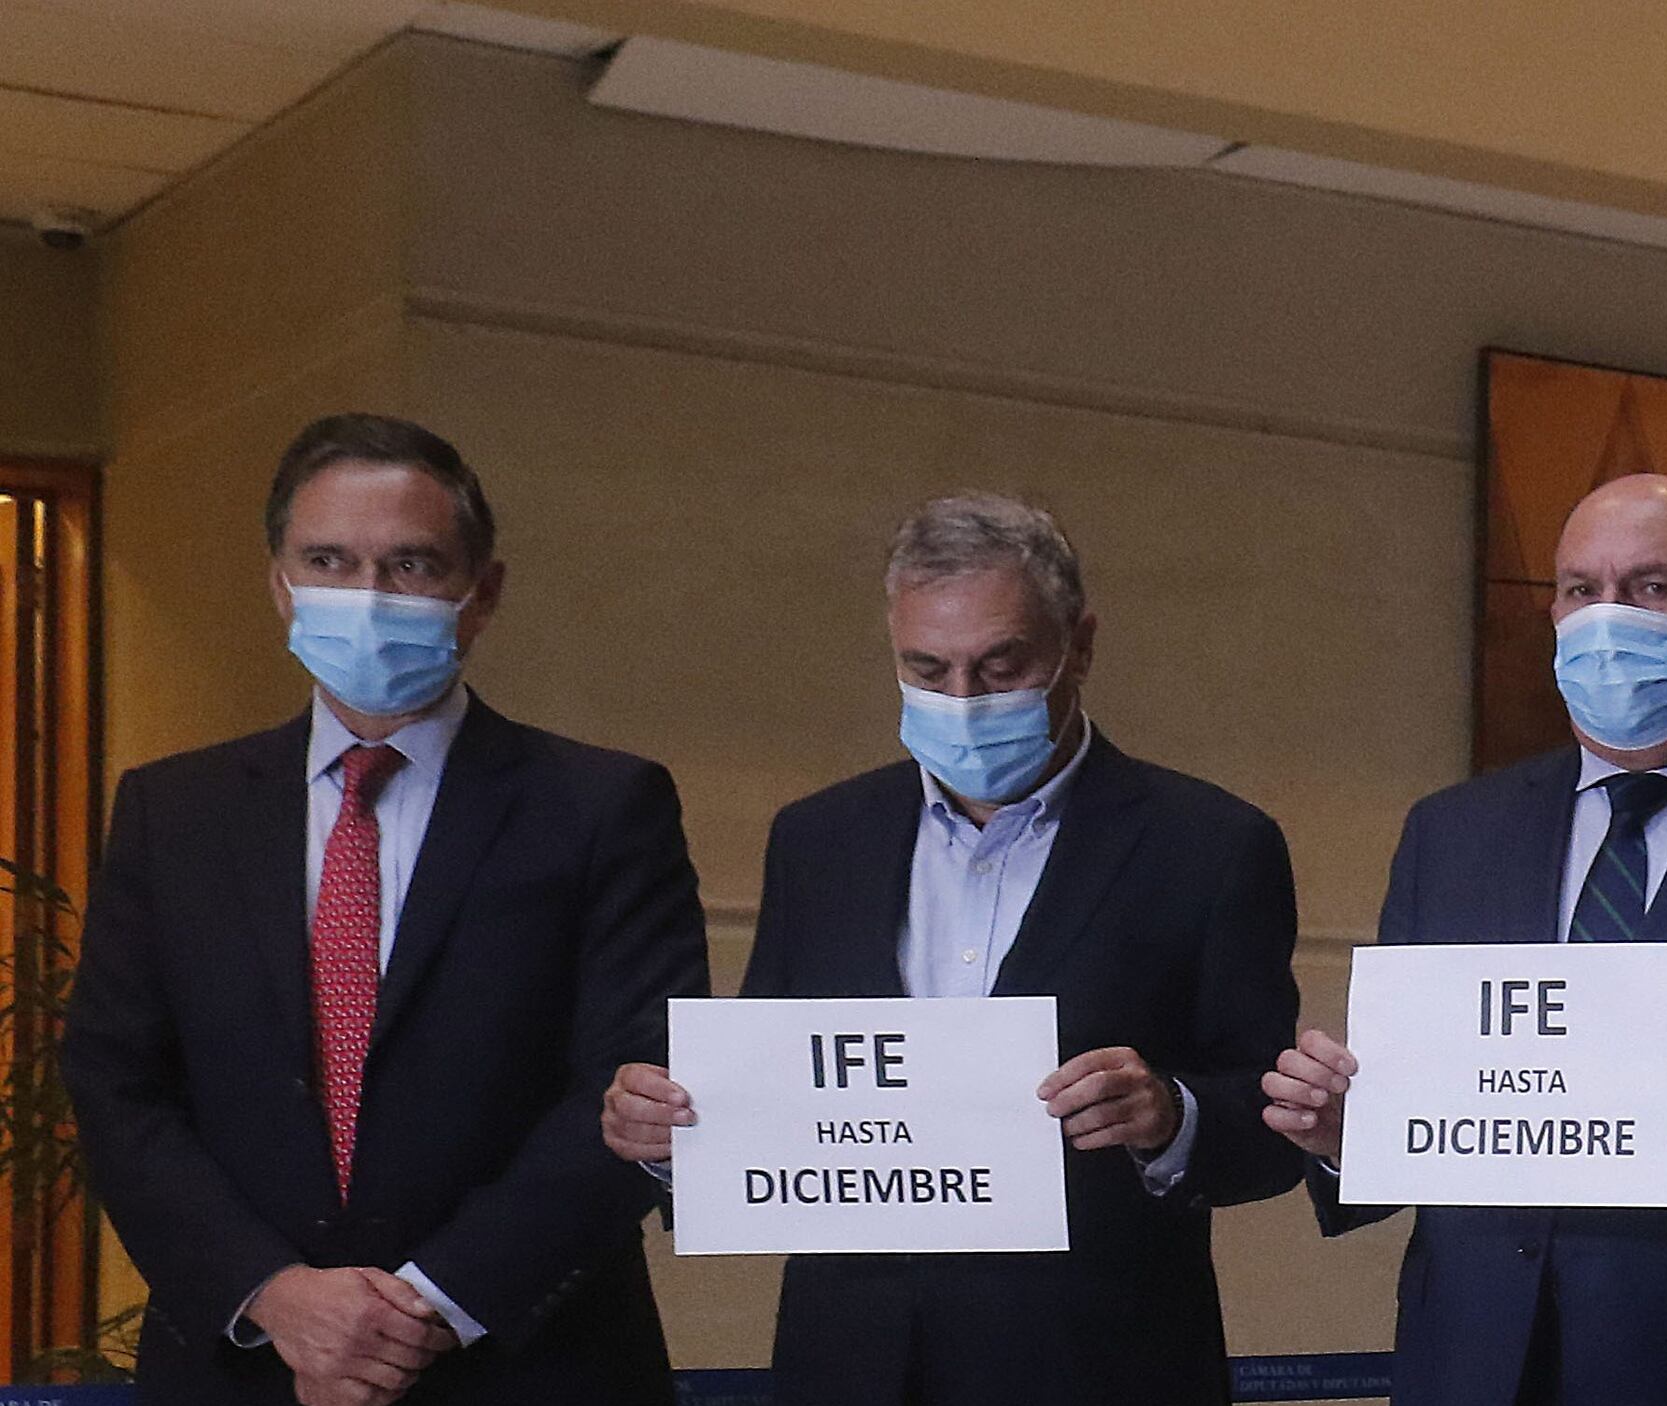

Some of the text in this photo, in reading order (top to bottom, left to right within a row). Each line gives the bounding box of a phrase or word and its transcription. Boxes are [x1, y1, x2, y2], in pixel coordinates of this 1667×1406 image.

[1479, 979, 1568, 1037] IFE
[809, 1032, 909, 1090] IFE
[1478, 1068, 1568, 1095] HASTA
[815, 1119, 914, 1145] HASTA
[1406, 1118, 1636, 1157] DICIEMBRE
[744, 1167, 994, 1205] DICIEMBRE
